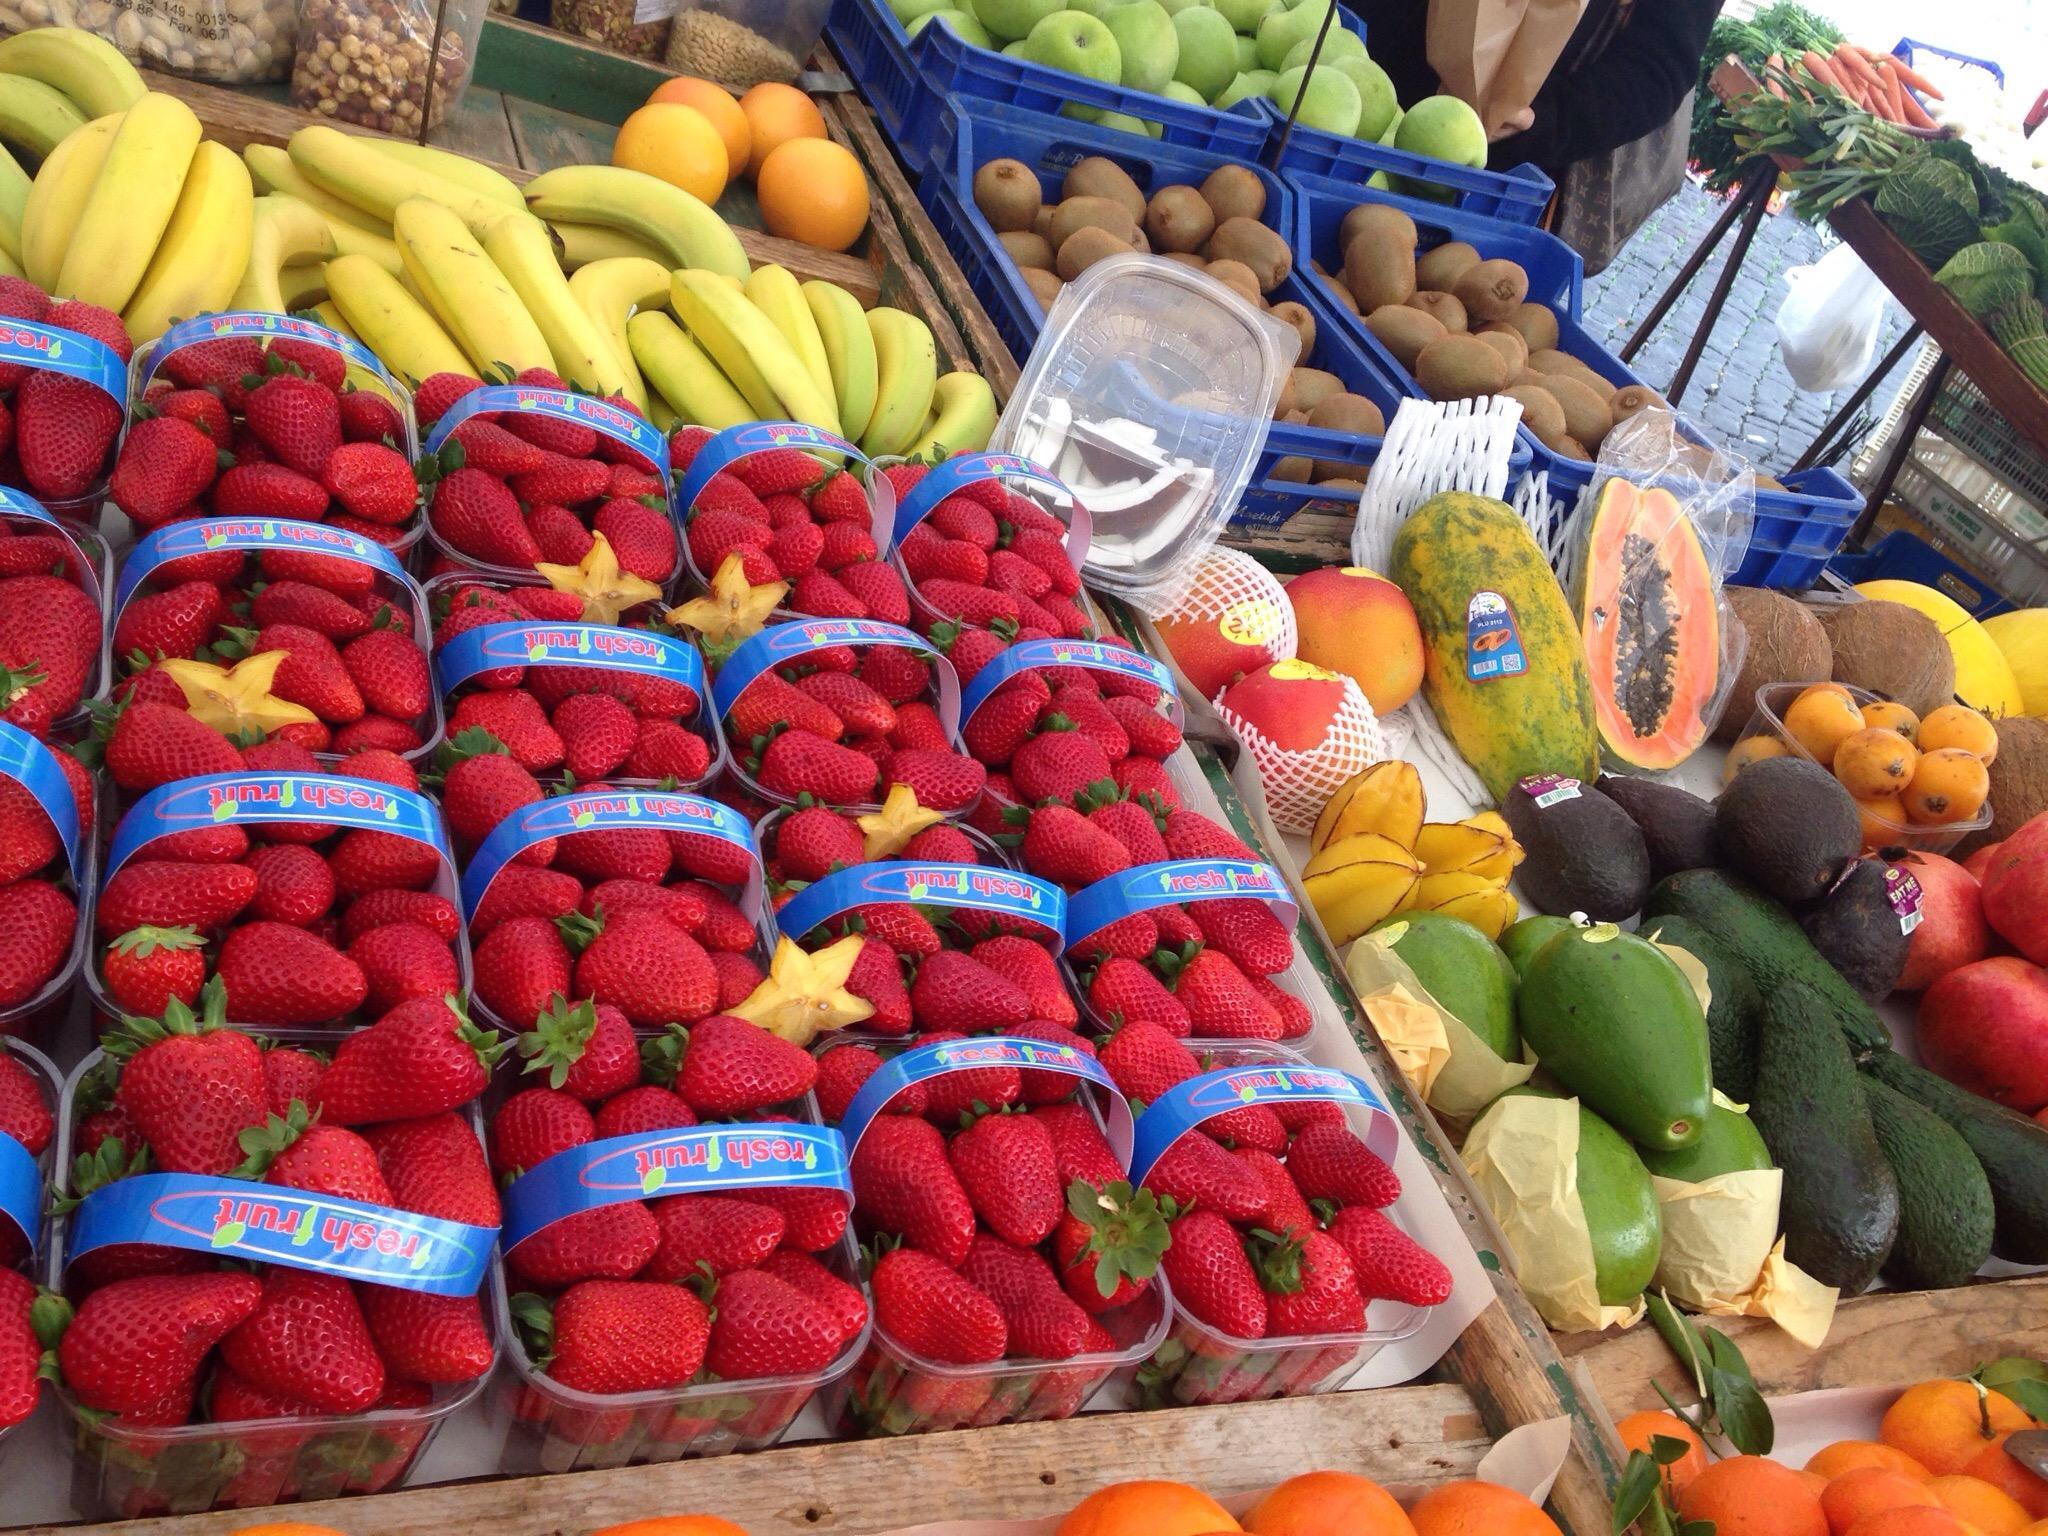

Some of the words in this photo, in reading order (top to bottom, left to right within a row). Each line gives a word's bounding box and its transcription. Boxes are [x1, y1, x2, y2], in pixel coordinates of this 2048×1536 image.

[169, 17, 192, 34] Fax
[517, 390, 575, 412] fruit
[579, 400, 641, 440] fresh
[201, 520, 275, 549] fruit
[280, 524, 367, 555] fresh
[524, 628, 591, 662] fruit
[594, 633, 666, 664] fresh
[208, 779, 296, 822] fruit
[301, 784, 399, 820] fresh
[568, 796, 641, 828] fruit
[644, 799, 724, 827] fresh
[905, 870, 969, 900] fruit
[972, 873, 1041, 909] fresh
[1160, 868, 1227, 893] fresh
[1226, 863, 1273, 893] fruit
[1889, 885, 1907, 904] EAT
[1905, 876, 1918, 892] ME
[935, 1042, 1022, 1065] fresh
[1226, 1070, 1292, 1103] fruit
[635, 1135, 722, 1194] fruit
[727, 1138, 817, 1169] fresh
[211, 1198, 319, 1248] fruit
[322, 1216, 434, 1270] fresh
